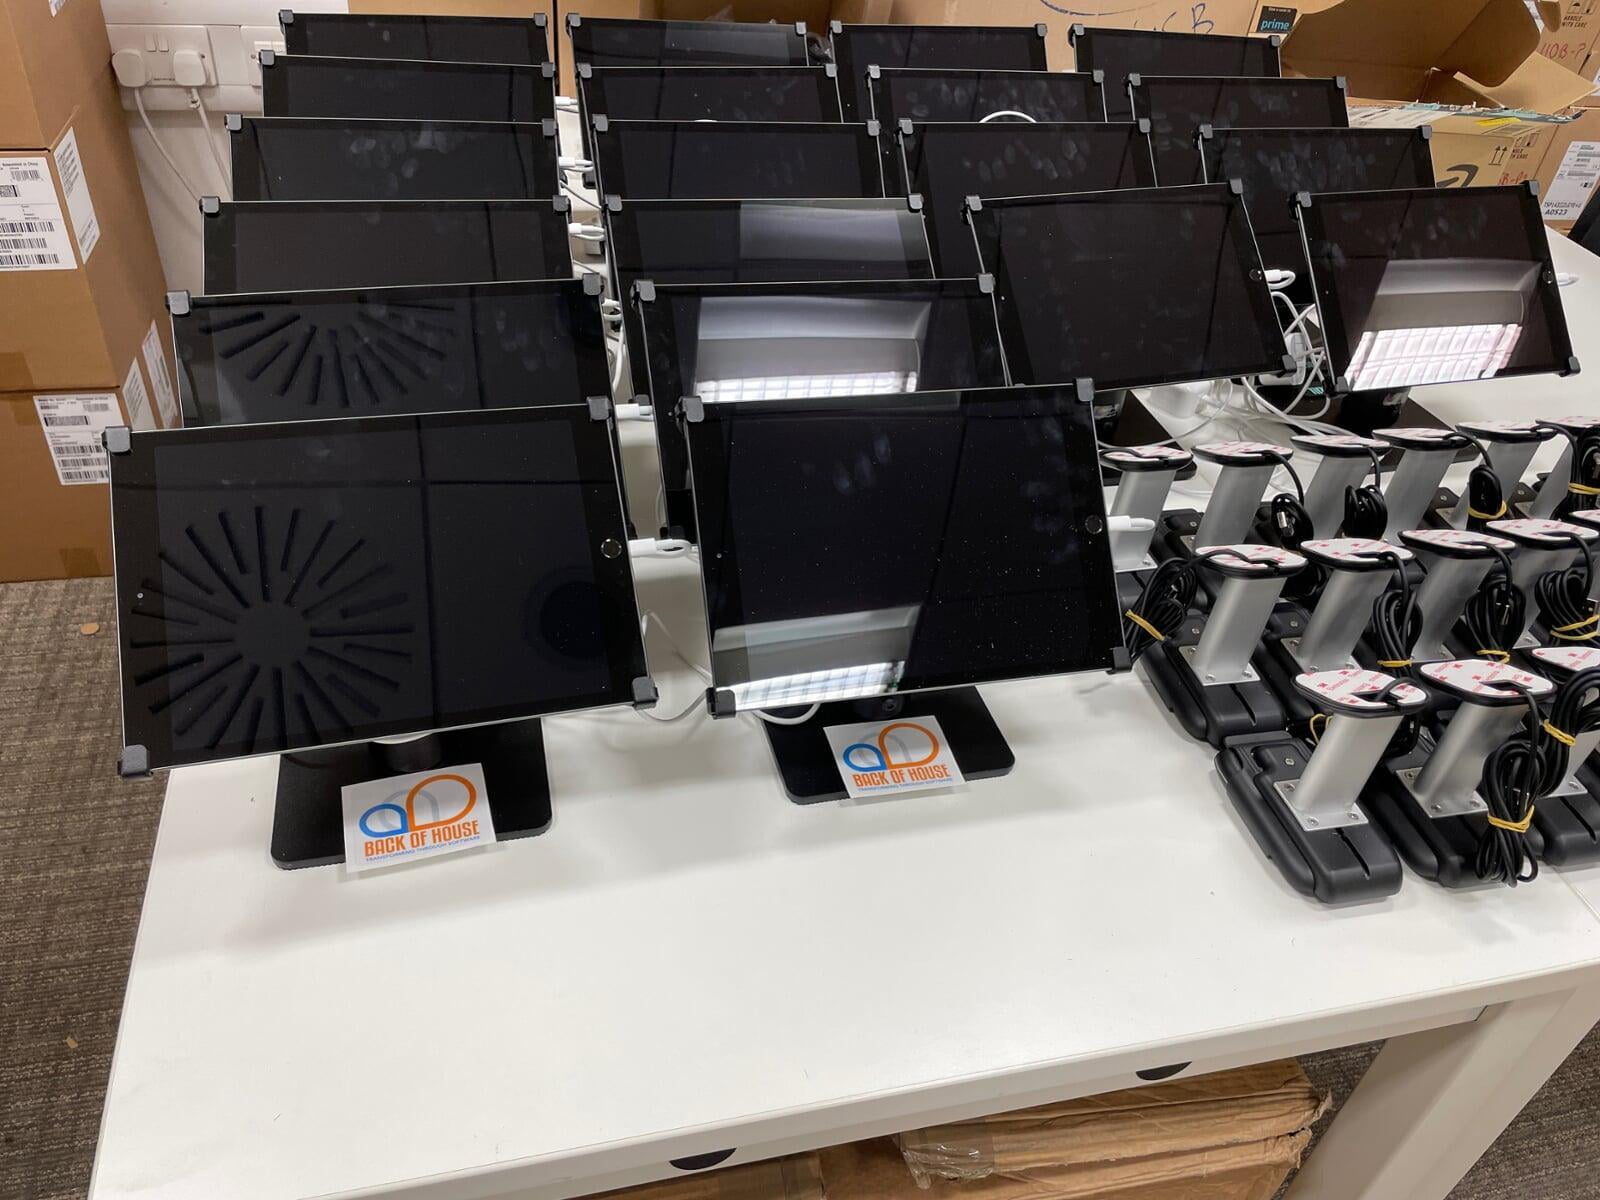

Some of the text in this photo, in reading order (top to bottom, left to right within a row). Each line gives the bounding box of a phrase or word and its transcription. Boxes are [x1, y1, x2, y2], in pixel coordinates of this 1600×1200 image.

[1260, 18, 1290, 31] prime
[852, 764, 951, 787] BACK OF HOUSE
[364, 820, 480, 857] BACK OF HOUSE
